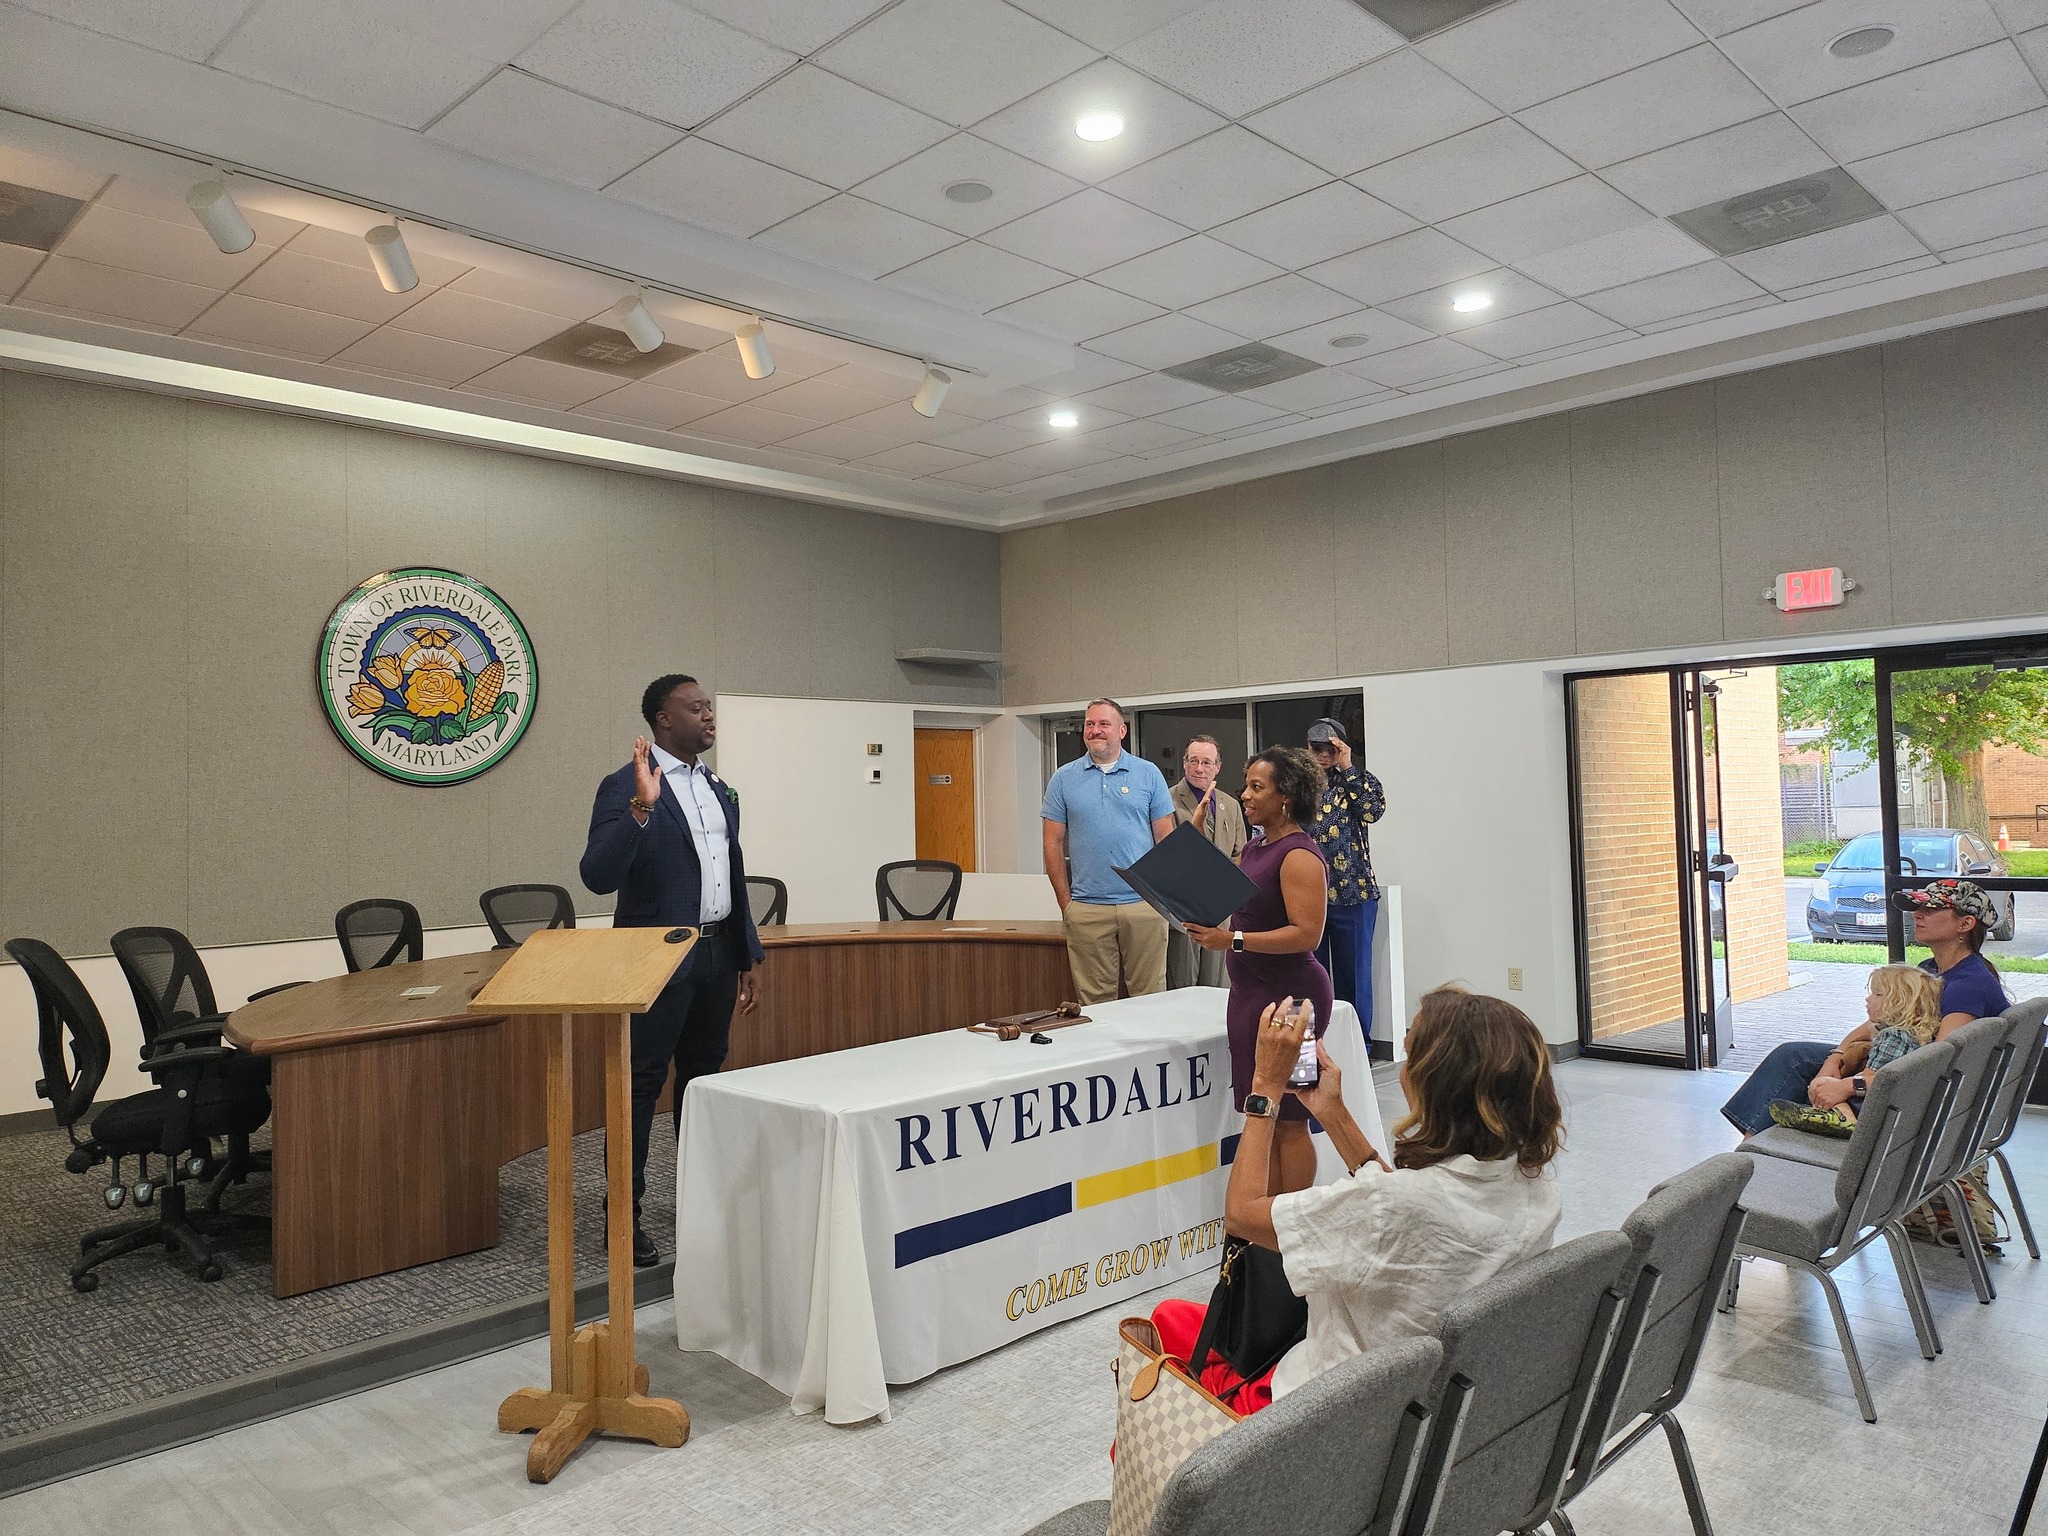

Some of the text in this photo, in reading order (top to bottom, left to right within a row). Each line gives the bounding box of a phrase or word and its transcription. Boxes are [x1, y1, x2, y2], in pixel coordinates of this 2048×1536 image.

[1786, 569, 1834, 607] EXIT
[338, 585, 522, 684] TOWN OF RIVERDALE PARK
[381, 734, 492, 767] MARYLAND
[895, 1053, 1212, 1172] RIVERDALE
[1006, 1262, 1089, 1321] COME
[1096, 1236, 1173, 1287] GROW
